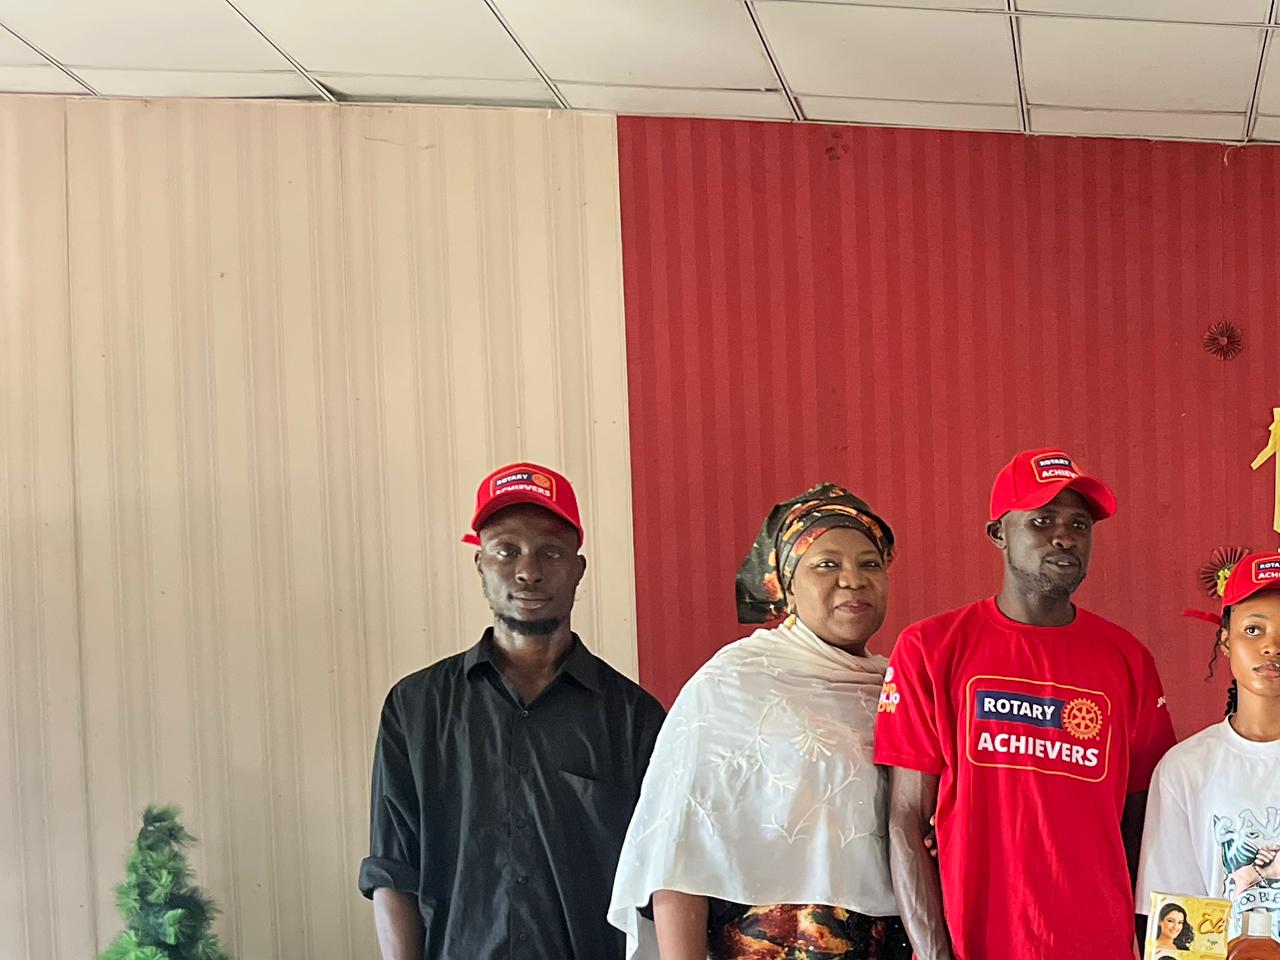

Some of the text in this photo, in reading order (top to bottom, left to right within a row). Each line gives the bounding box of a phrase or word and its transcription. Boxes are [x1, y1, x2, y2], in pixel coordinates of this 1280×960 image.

[496, 473, 529, 486] ROTARY
[983, 697, 1055, 720] ROTARY
[977, 732, 1099, 767] ACHIEVERS
